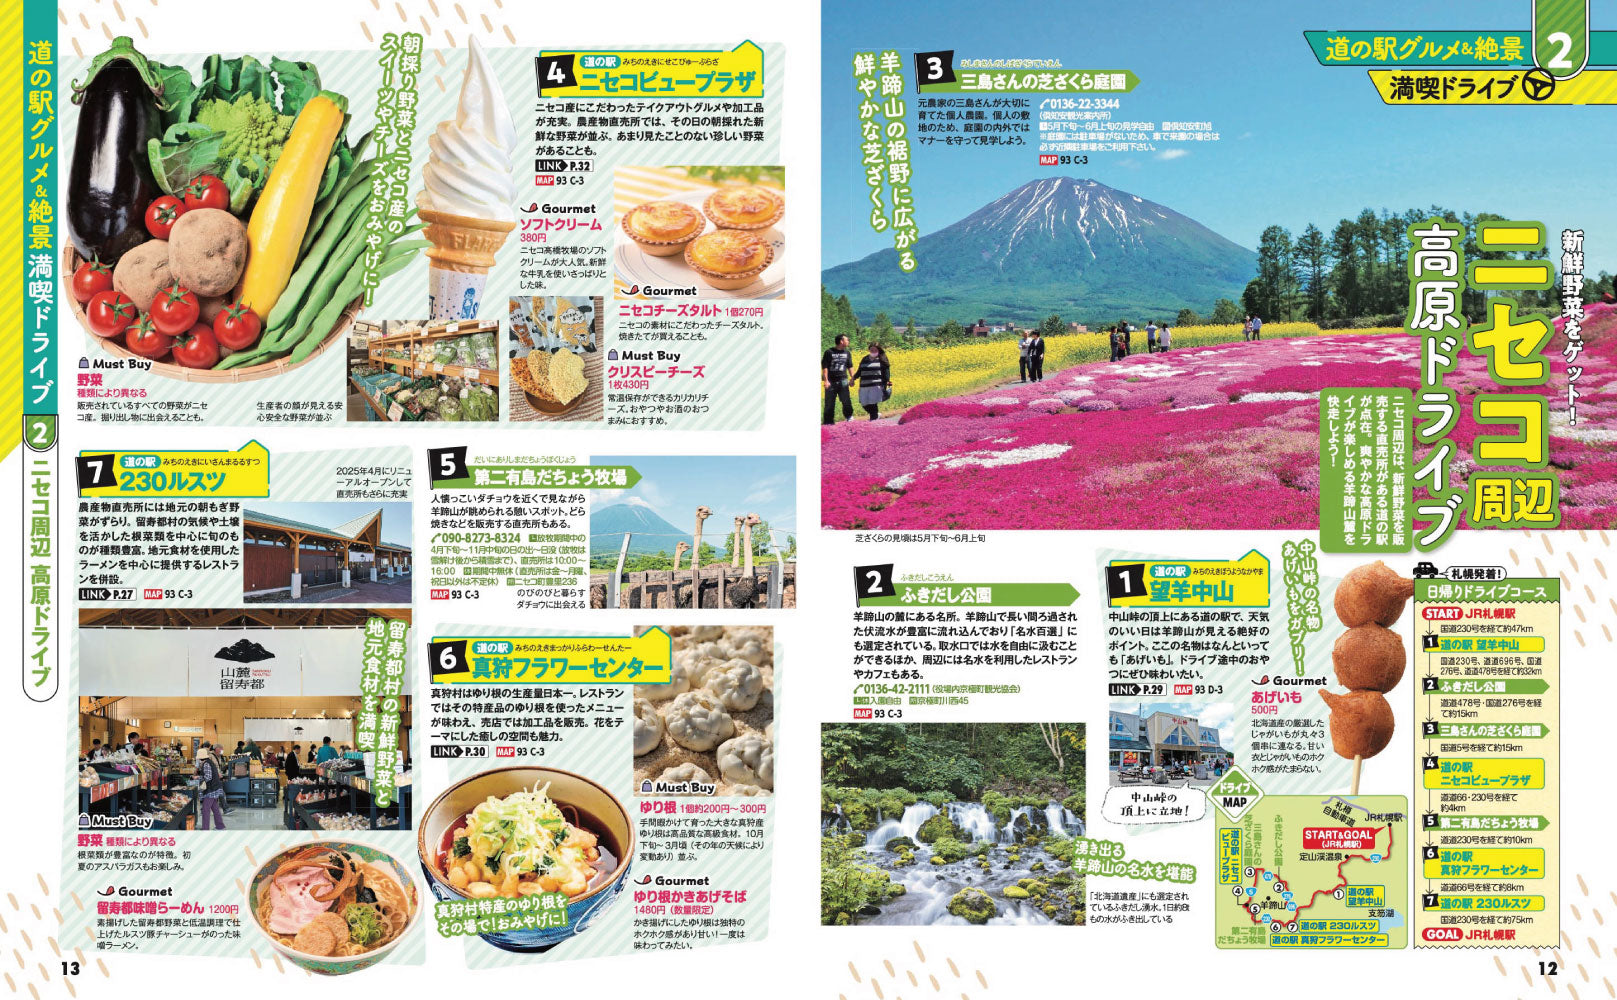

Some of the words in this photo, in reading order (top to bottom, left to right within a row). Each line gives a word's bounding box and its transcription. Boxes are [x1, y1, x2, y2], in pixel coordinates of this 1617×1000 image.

[1325, 36, 1525, 62] 道の駅グルメ&絶景
[1547, 32, 1573, 69] 2
[585, 56, 617, 67] 道の駅
[546, 62, 566, 83] 4
[927, 57, 943, 80] 3
[580, 71, 755, 92] ニセコビュープラザ
[960, 73, 1126, 90] 三島さんの芝ざくら庭園
[1390, 75, 1519, 101] 満喫ドライブ
[535, 103, 764, 113] ニセコ産にこだわったテイクアウトグルメや加工品
[918, 99, 1030, 108] 元農家の三島さんが大切に
[1050, 99, 1120, 109] 0136-22-3344
[918, 111, 1030, 120] 育てた個人農園。個人の敷
[535, 117, 764, 127] が充実。農産物直売所では、その日の朝採れた新
[918, 123, 1030, 133] 地のため、庭園の内外では
[387, 34, 421, 234] 朝採り野菜とニセコ産の
[535, 131, 764, 141] 鮮な野菜が並ぶ。あまり見たことのない珍しい野菜
[28, 41, 54, 249] 道の駅グルメ&絶景
[853, 54, 887, 231] 鮮やかな芝ざくら
[918, 136, 1028, 146] マナーを守って見学しよう。
[535, 146, 597, 156] があることも。
[880, 51, 916, 270] 羊蹄山の裾野に広がる
[542, 203, 596, 213] Gourmet
[520, 218, 602, 231] ソフトクリーム
[520, 233, 546, 242] 380円
[520, 246, 607, 255] ニセコ高橋牧場のソフト
[520, 258, 607, 266] クリームが大人気。新鮮
[520, 270, 607, 278] な牛乳を使いさっぱりと
[642, 286, 697, 297] Gourmet
[619, 304, 722, 317] ニセコチーズタルト
[28, 254, 54, 404] 満喫ドライブ
[619, 321, 764, 330] ニセコの素材にこだわったチーズタルト。
[619, 332, 708, 341] 焼きたてが買えることも。
[622, 351, 652, 361] Must
[657, 351, 681, 363] Buy
[93, 359, 124, 369] Must
[128, 359, 152, 371] Buy
[608, 365, 705, 378] クリスピーチーズ
[77, 373, 103, 386] 野菜
[608, 380, 649, 390] 1枚430円
[1410, 223, 1463, 547] 高原ドライブ
[77, 388, 147, 398] 種類により異なる
[257, 401, 343, 410] 生産者の顔が見える安
[257, 413, 332, 422] 心安全な野菜が並ぶ
[33, 423, 47, 443] 2
[125, 456, 157, 467] 道の駅
[441, 453, 456, 476] 5
[87, 461, 103, 484] 7
[336, 467, 412, 476] 2025年4月にリニュ
[1343, 395, 1356, 546] イブが楽しめる羊蹄山麓を
[1360, 395, 1372, 546] が点在。爽やかな高原ドラ
[1376, 395, 1388, 546] 売する直売所がある道の駅
[1392, 395, 1405, 546] ニセコ周辺は、新鮮野菜を販
[120, 472, 226, 491] 230ルスツ
[336, 477, 411, 487] ーアルオープンして
[474, 469, 627, 486] 第二有島だちょう牧場
[336, 489, 408, 498] 直売所もさらに充実
[430, 493, 586, 504] 人懐っこいダチョウを近くで見ながら
[30, 460, 51, 558] ニセコ周辺
[79, 502, 240, 513] 農産物直売所には地元の朝もぎ野
[430, 507, 586, 517] 羊蹄山が眺められる憩いスポット。どら
[79, 517, 240, 527] 菜がずらり。留寿都村の気候や土壌
[430, 519, 571, 529] 焼きなどを販売する直売所もある。
[79, 531, 240, 541] を活かした根菜類を中心に旬のも
[79, 545, 240, 556] のが種類豊富。地元食材を使用した
[79, 559, 240, 570] ラーメンを中心に提供するレストラ
[1154, 566, 1186, 577] 道の駅
[865, 570, 883, 593] 2
[1119, 570, 1131, 593] 1
[1300, 541, 1321, 629] 中山峠の名物
[900, 587, 992, 604] ふきだし公園
[1150, 580, 1234, 602] 望羊中山
[1427, 585, 1548, 599] 日帰りドライブコース
[853, 612, 1078, 622] 羊蹄山の麓にある名所。羊蹄山で長い間ろ過され
[1108, 612, 1270, 622] 中山峠の頂上にある道の駅で、天気
[1426, 608, 1460, 619] START
[1466, 608, 1516, 619] JR札幌駅
[30, 564, 52, 687] 高原ドライブ
[1440, 624, 1534, 633] 国道230号を経て約47km
[853, 626, 1078, 637] た伏流水が豊富に流れ込んでおり「名水百選」に
[1108, 626, 1270, 637] のいい日は羊蹄山が見える絶好の
[477, 643, 509, 653] 道の駅
[853, 641, 1078, 651] も選定されている。取水口では水を自由に汲むこと
[1108, 641, 1269, 651] ポイント。ここの名物はなんといって
[1476, 640, 1520, 650] 望羊中山
[439, 647, 456, 669] 6
[853, 655, 1078, 665] ができるほか、周辺には名水を利用したレストラン
[1108, 655, 1270, 665] も「あげいも」。ドライブ途中のおや
[472, 657, 663, 679] 真狩フラワーセンター
[1108, 669, 1204, 680] つにぜひ味わいたい。
[220, 679, 265, 689] 留寿都
[358, 619, 385, 749] 地元食材を満喫
[1273, 676, 1327, 687] Gourmet
[430, 688, 624, 699] 真狩村はゆり根の生産量日本一。レストラン
[1251, 691, 1302, 704] あげいも
[375, 621, 406, 805] 留寿都村の新鮮野菜と
[430, 703, 624, 713] ではその特産品のゆり根を使ったメニュー
[1251, 705, 1278, 715] 500円
[430, 717, 624, 728] が味わえ、売店では加工品を販売。花をテ
[1251, 719, 1325, 728] 北海道産の厳選した
[430, 731, 564, 742] ーマにした癒しの空間も魅力。
[1251, 730, 1325, 739] じゃがいもが丸々3
[1440, 726, 1542, 737] 三島さんの芝ざくら庭園
[1251, 742, 1325, 751] 個串に連なる。甘い
[1251, 753, 1325, 762] 衣とじゃがいものホク
[1251, 764, 1323, 774] ホク感がたまらない。
[1440, 775, 1531, 786] ニセコビュープラザ
[655, 782, 686, 793] Must
[690, 782, 715, 795] Buy
[1131, 792, 1178, 803] 中山峠の
[1223, 797, 1247, 808] MAP
[640, 801, 677, 814] ゆり根
[93, 815, 126, 828] Must
[128, 815, 152, 830] Buy
[1365, 813, 1403, 822] JR札幌駅
[1440, 817, 1539, 829] 第二有島だちょう牧場
[1305, 830, 1373, 839] START&GOAL
[77, 834, 103, 847] 野菜
[106, 837, 176, 847] 種類により異なる
[1075, 840, 1123, 857] 湧き出る
[1222, 832, 1231, 883] ビュープラザ
[1299, 853, 1342, 861] 定山渓温泉
[77, 862, 185, 871] 夏のアスパラガスもお楽しみ。
[1074, 858, 1195, 881] 羊蹄山の名水を堪能
[1440, 864, 1539, 875] 真狩フラワーセンター
[655, 876, 710, 886] Gourmet
[118, 886, 173, 897] Gourmet
[634, 889, 747, 903] ゆり根かきあげそば
[1089, 892, 1190, 901] 「北海道遺産」にも選定され
[97, 901, 204, 915] 留寿都味噌らーめん
[437, 895, 568, 918] 真狩村特産のゆり根を
[1260, 901, 1286, 910] 羊蹄山
[1476, 898, 1531, 909] 230ルスツ
[1301, 935, 1386, 944] 真狩フラワーセンター
[1427, 929, 1459, 939] GOAL
[1465, 929, 1516, 941] JR札幌駅
[61, 961, 80, 976] 13
[1538, 961, 1558, 976] 12
